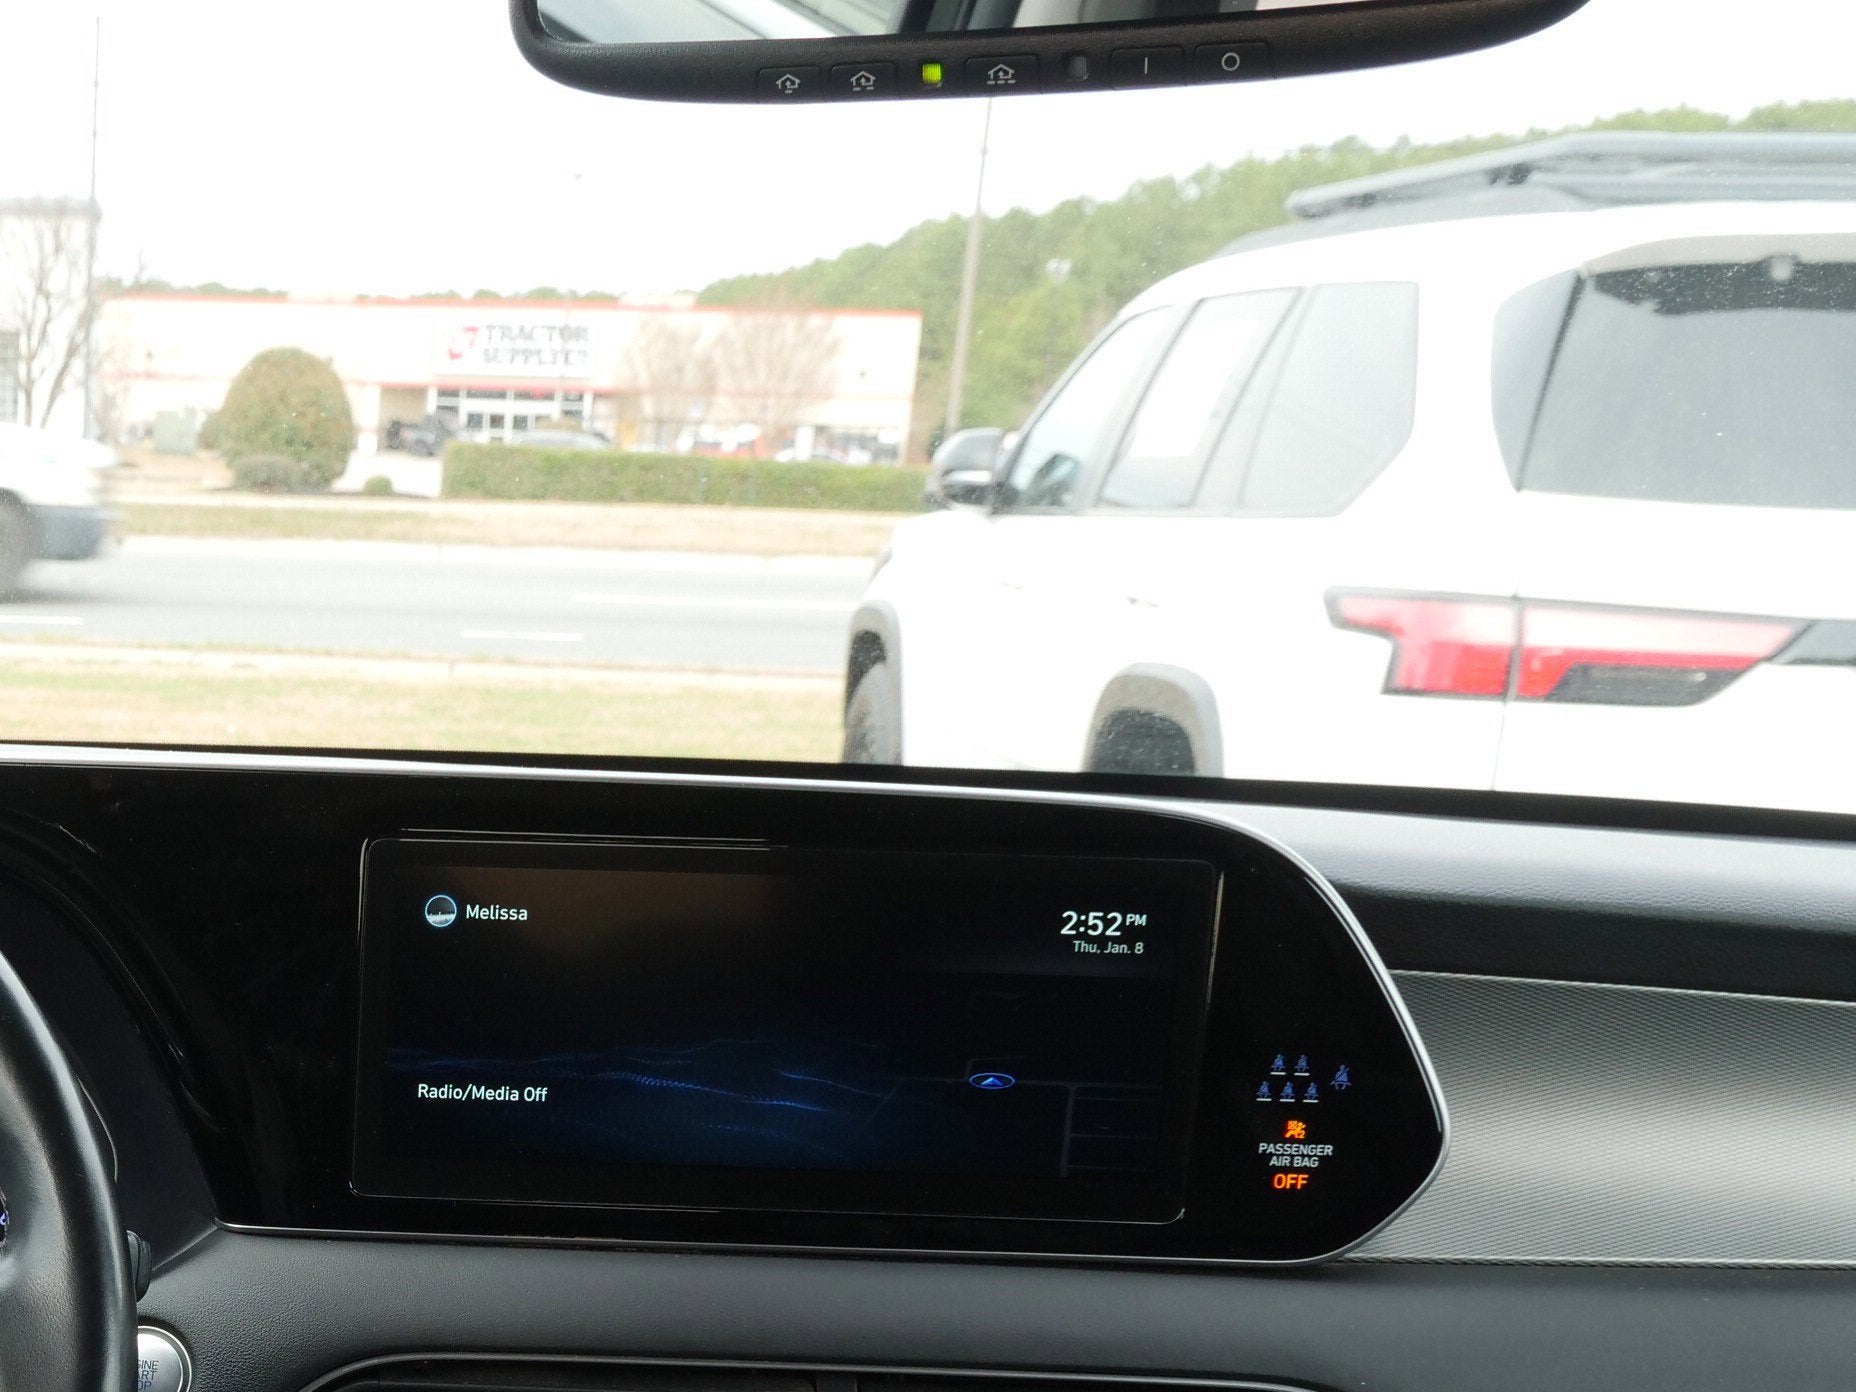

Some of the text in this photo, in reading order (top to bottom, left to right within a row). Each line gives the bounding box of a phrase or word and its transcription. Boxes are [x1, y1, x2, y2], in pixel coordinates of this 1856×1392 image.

[465, 904, 529, 921] Melissa
[1060, 910, 1147, 936] 2:52 PM
[1073, 940, 1144, 954] Thu, Jan. 8
[418, 1084, 548, 1102] Radio/Media Off
[1258, 1142, 1334, 1156] PASSENGER
[1269, 1155, 1319, 1168] AIR BAG
[1273, 1173, 1309, 1189] OFF
